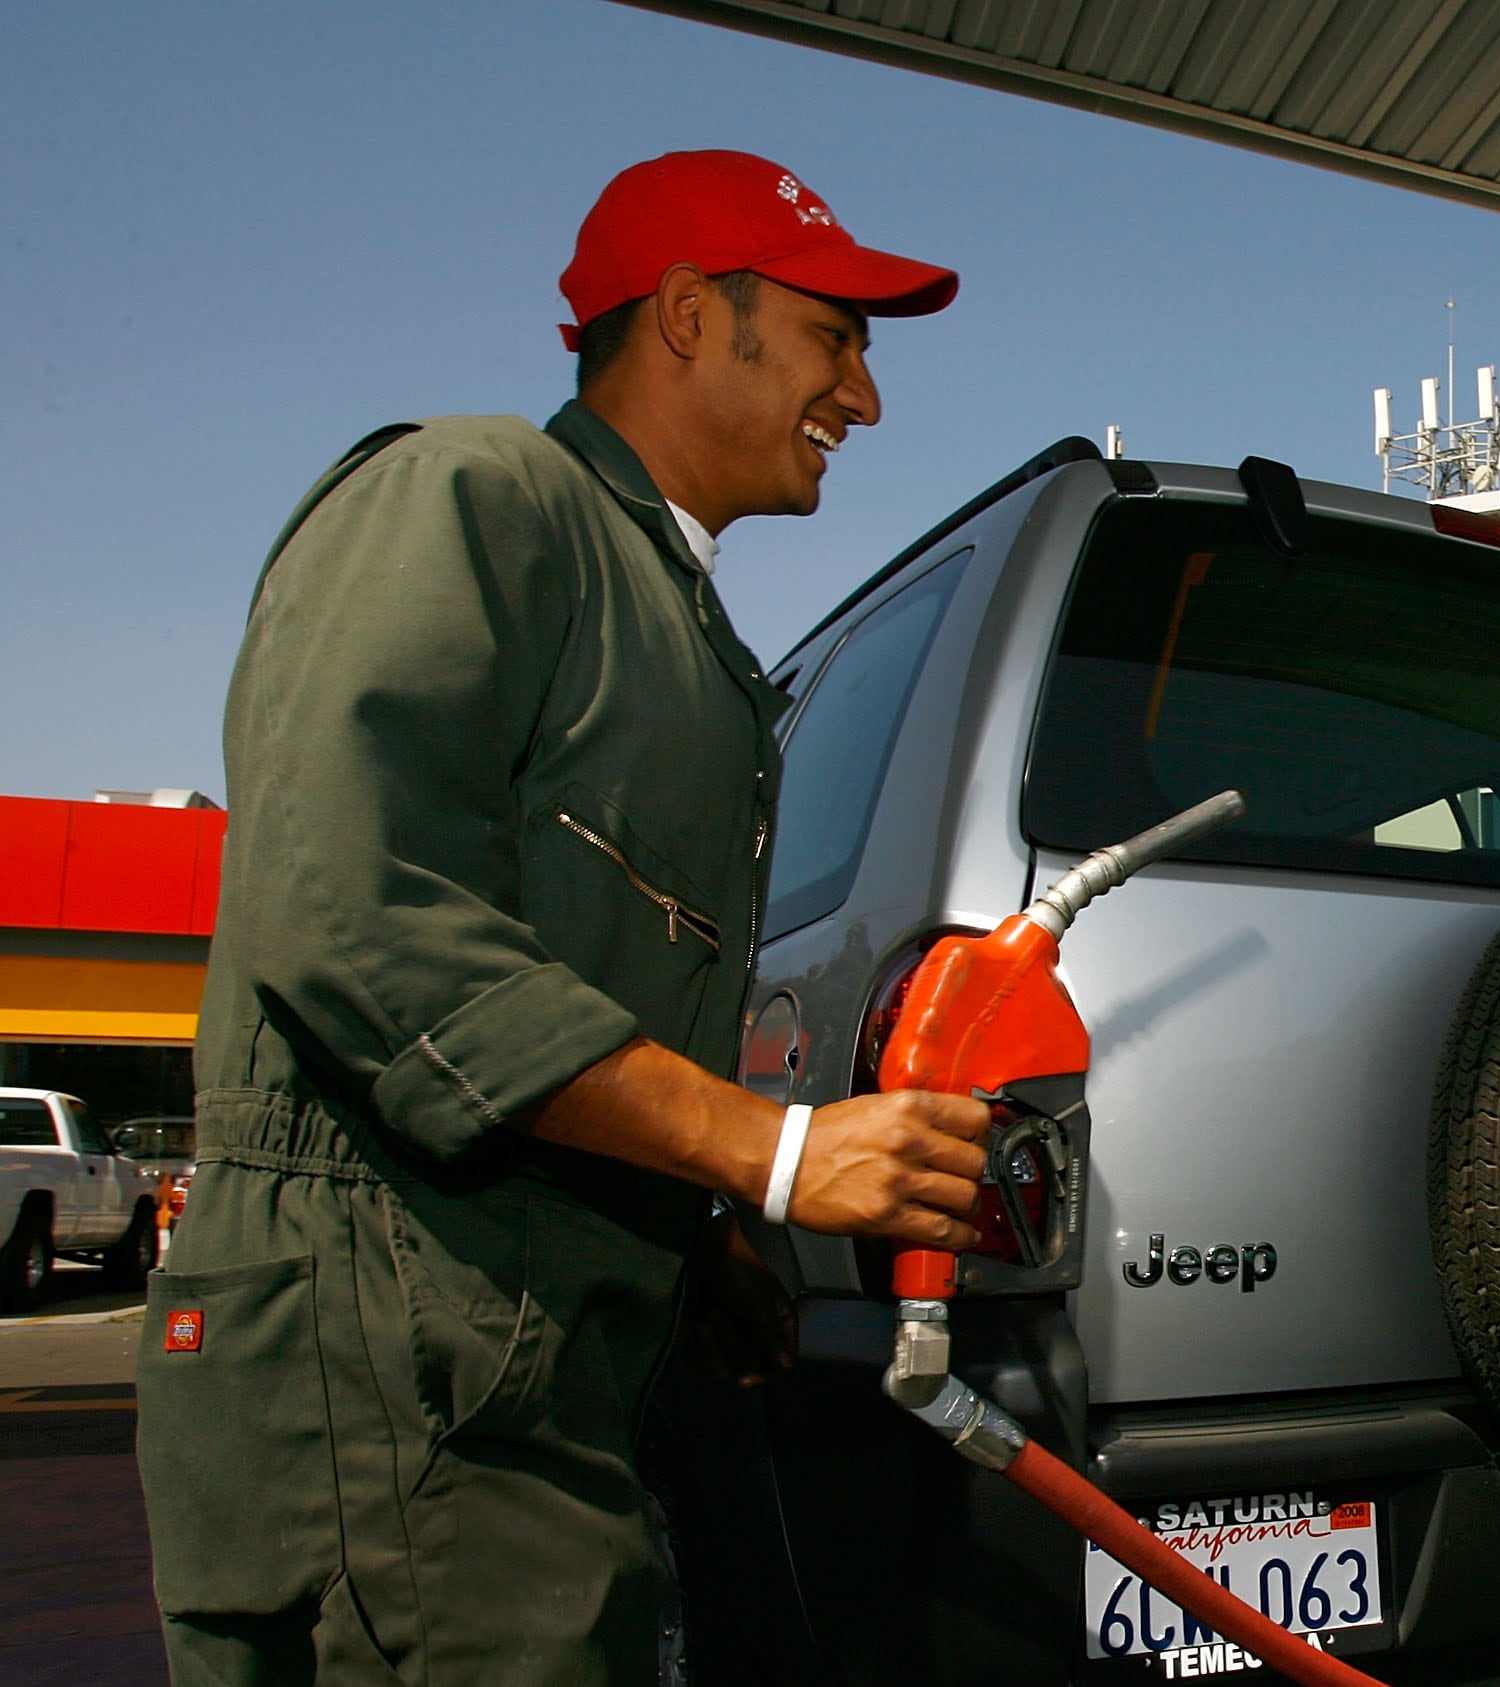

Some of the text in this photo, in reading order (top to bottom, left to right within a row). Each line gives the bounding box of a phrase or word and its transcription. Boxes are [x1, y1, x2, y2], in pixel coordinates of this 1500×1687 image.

[1122, 1233, 1277, 1292] Jeep
[1156, 1491, 1314, 1531] SATURN
[1338, 1504, 1365, 1519] 2008
[1155, 1517, 1332, 1562] alifornia
[1100, 1549, 1369, 1657] 6CW063
